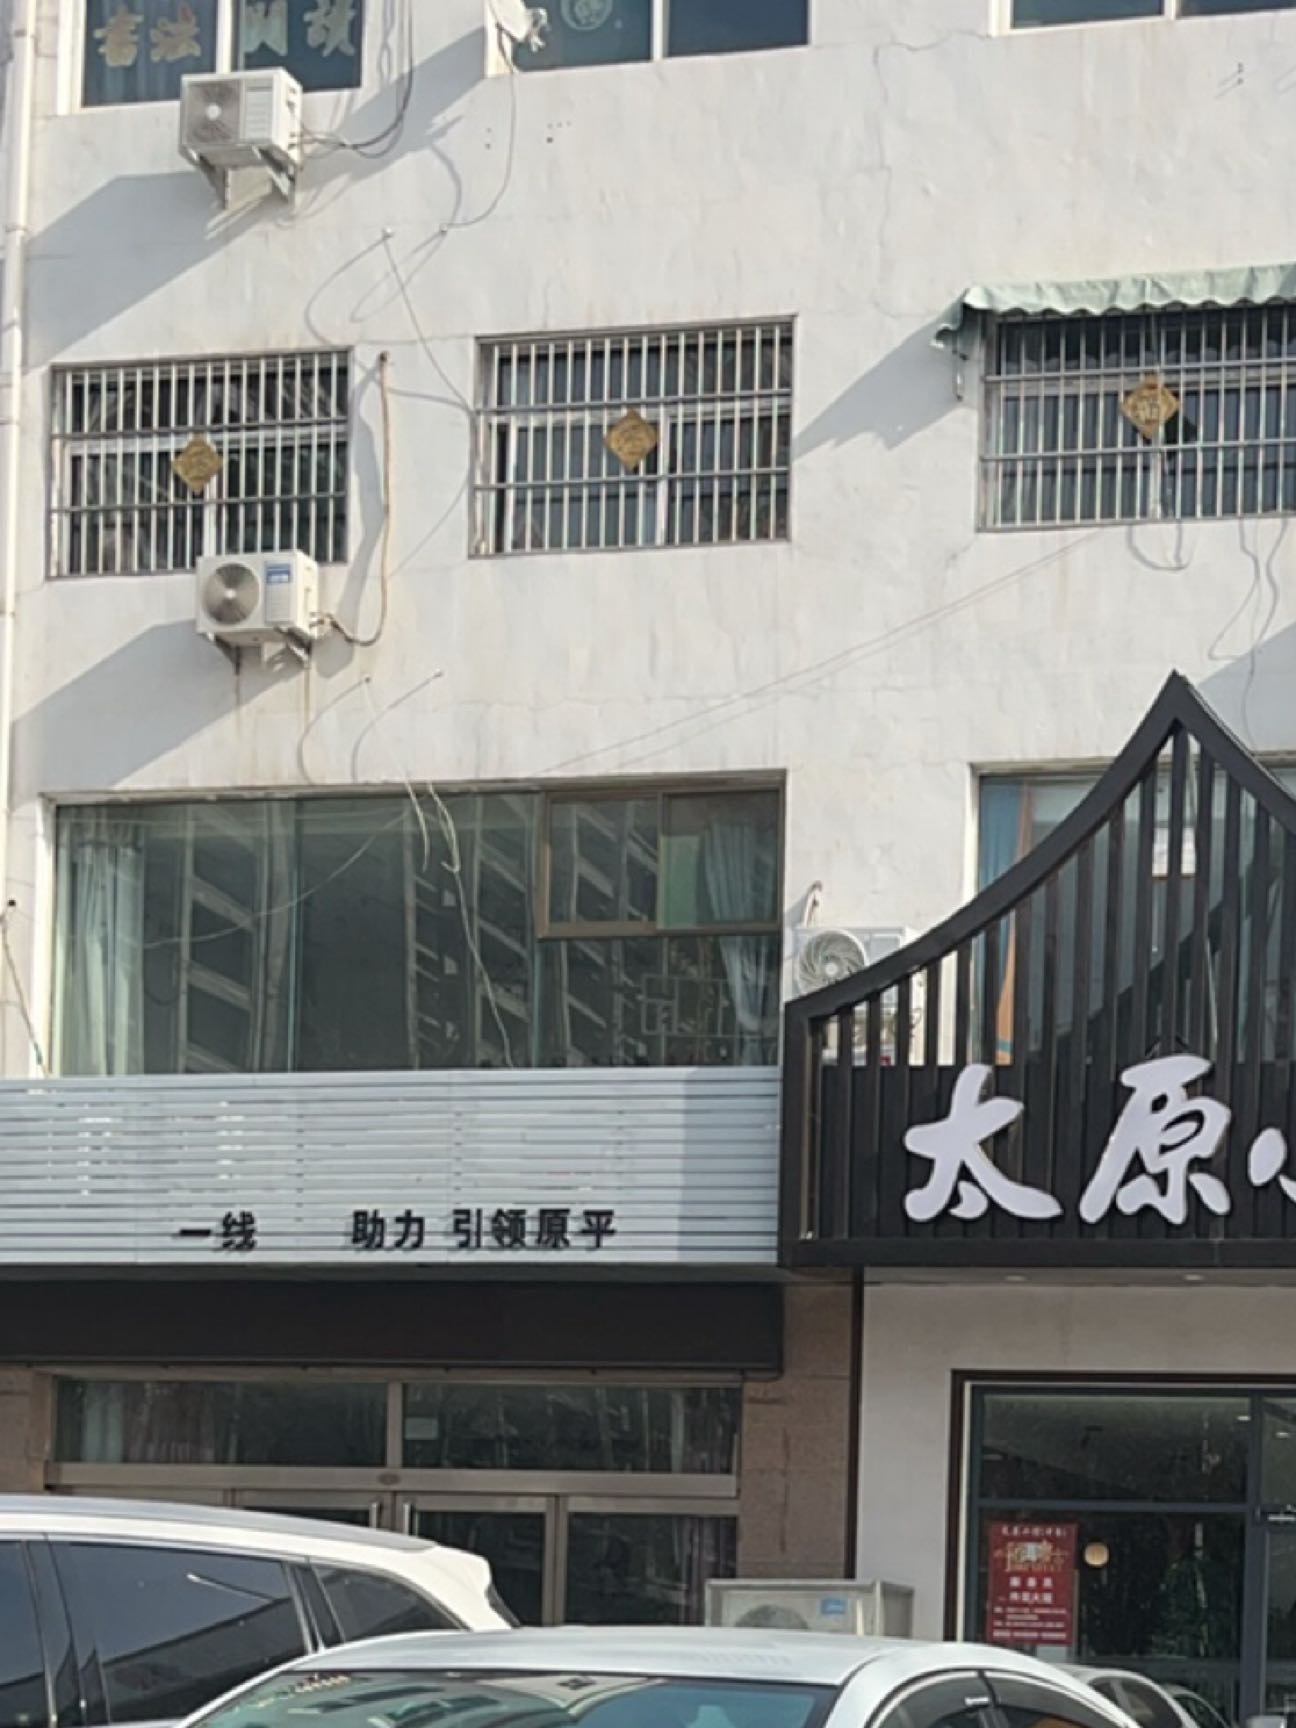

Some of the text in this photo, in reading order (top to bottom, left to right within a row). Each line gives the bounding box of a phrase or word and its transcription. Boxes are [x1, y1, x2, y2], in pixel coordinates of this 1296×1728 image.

[178, 1208, 616, 1250] 一线 助力 引领原平
